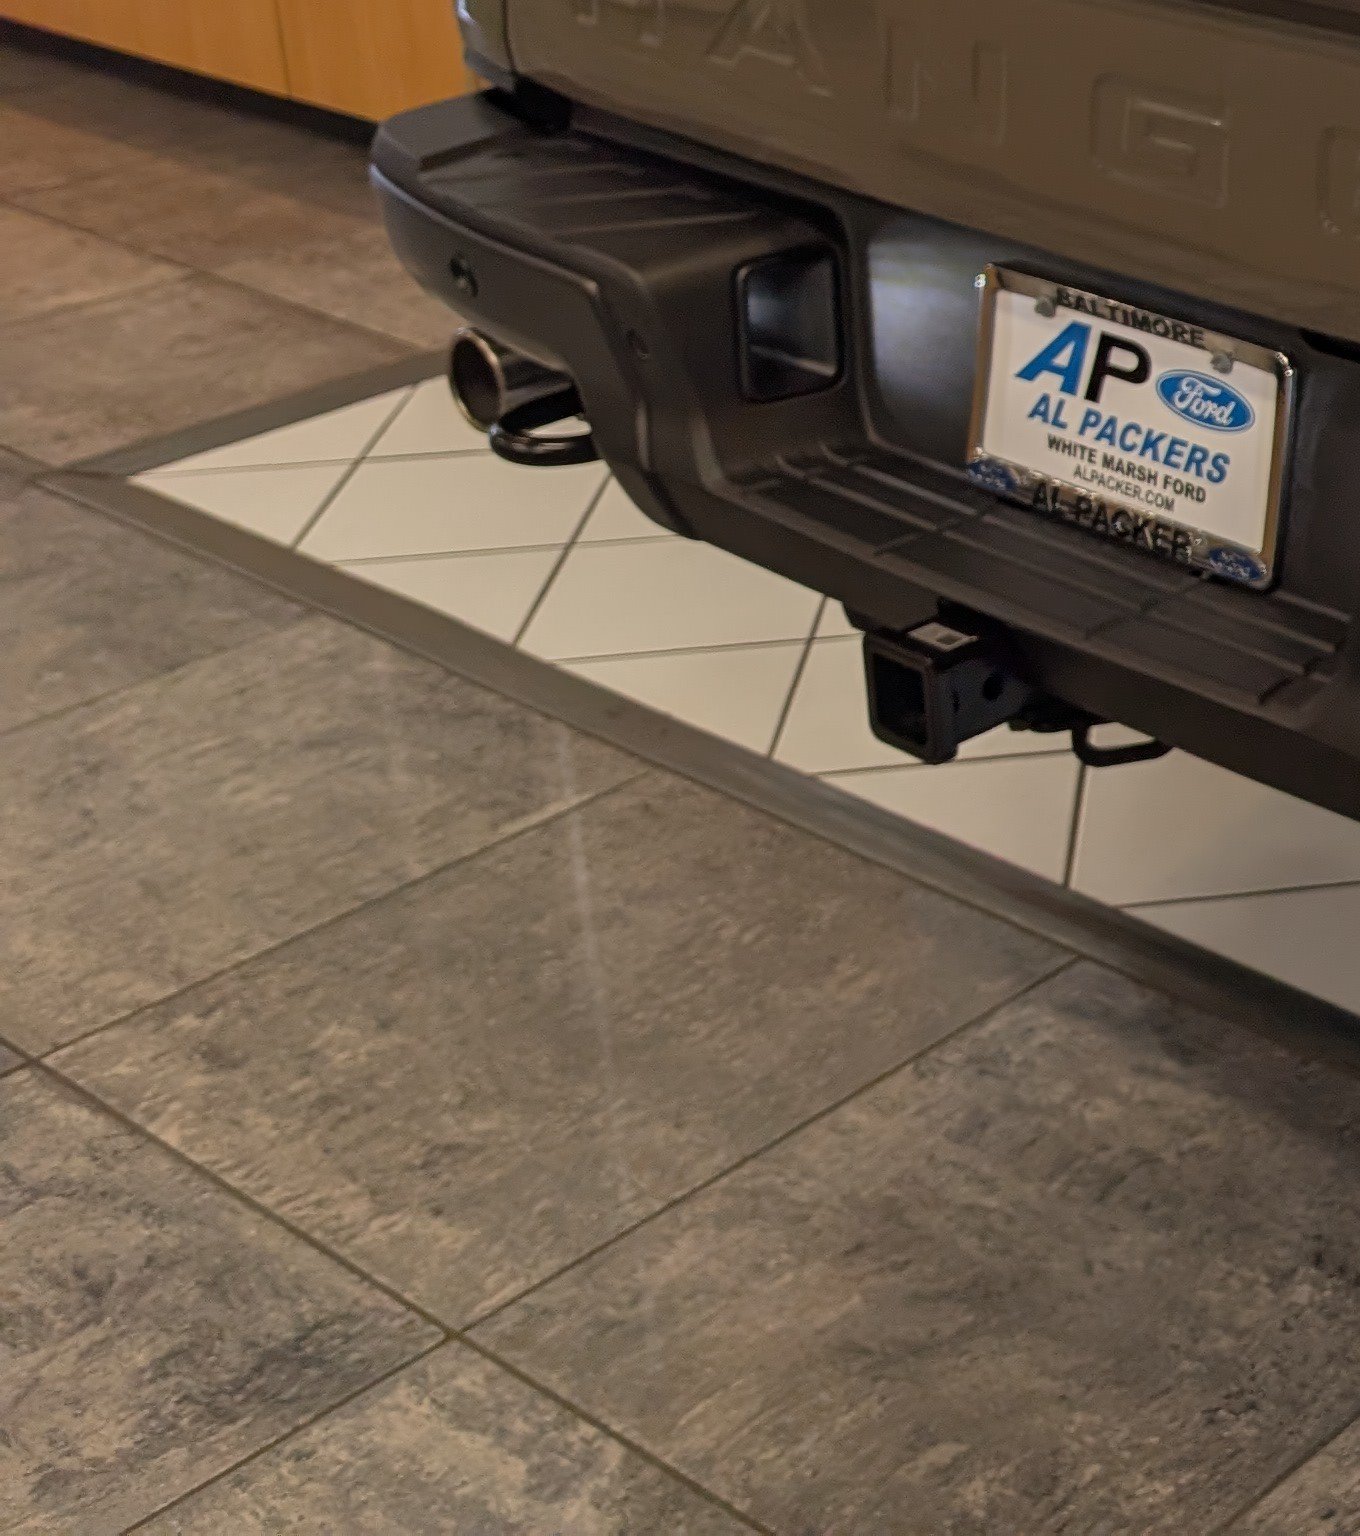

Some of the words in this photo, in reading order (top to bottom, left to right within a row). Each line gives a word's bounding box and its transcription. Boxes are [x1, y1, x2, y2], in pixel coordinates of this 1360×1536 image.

[1055, 286, 1208, 350] BALTIMORE
[1015, 319, 1152, 403] AP
[1173, 376, 1237, 426] Ford
[1027, 392, 1068, 430] AL
[1077, 407, 1231, 483] PACKERS
[1047, 432, 1098, 464] WHITE
[1101, 451, 1158, 486] MARSH
[1162, 473, 1208, 504] FORD
[1031, 482, 1061, 514] AL
[1074, 494, 1194, 564] PACKER
[1072, 463, 1176, 513] ALPACKER.COM
